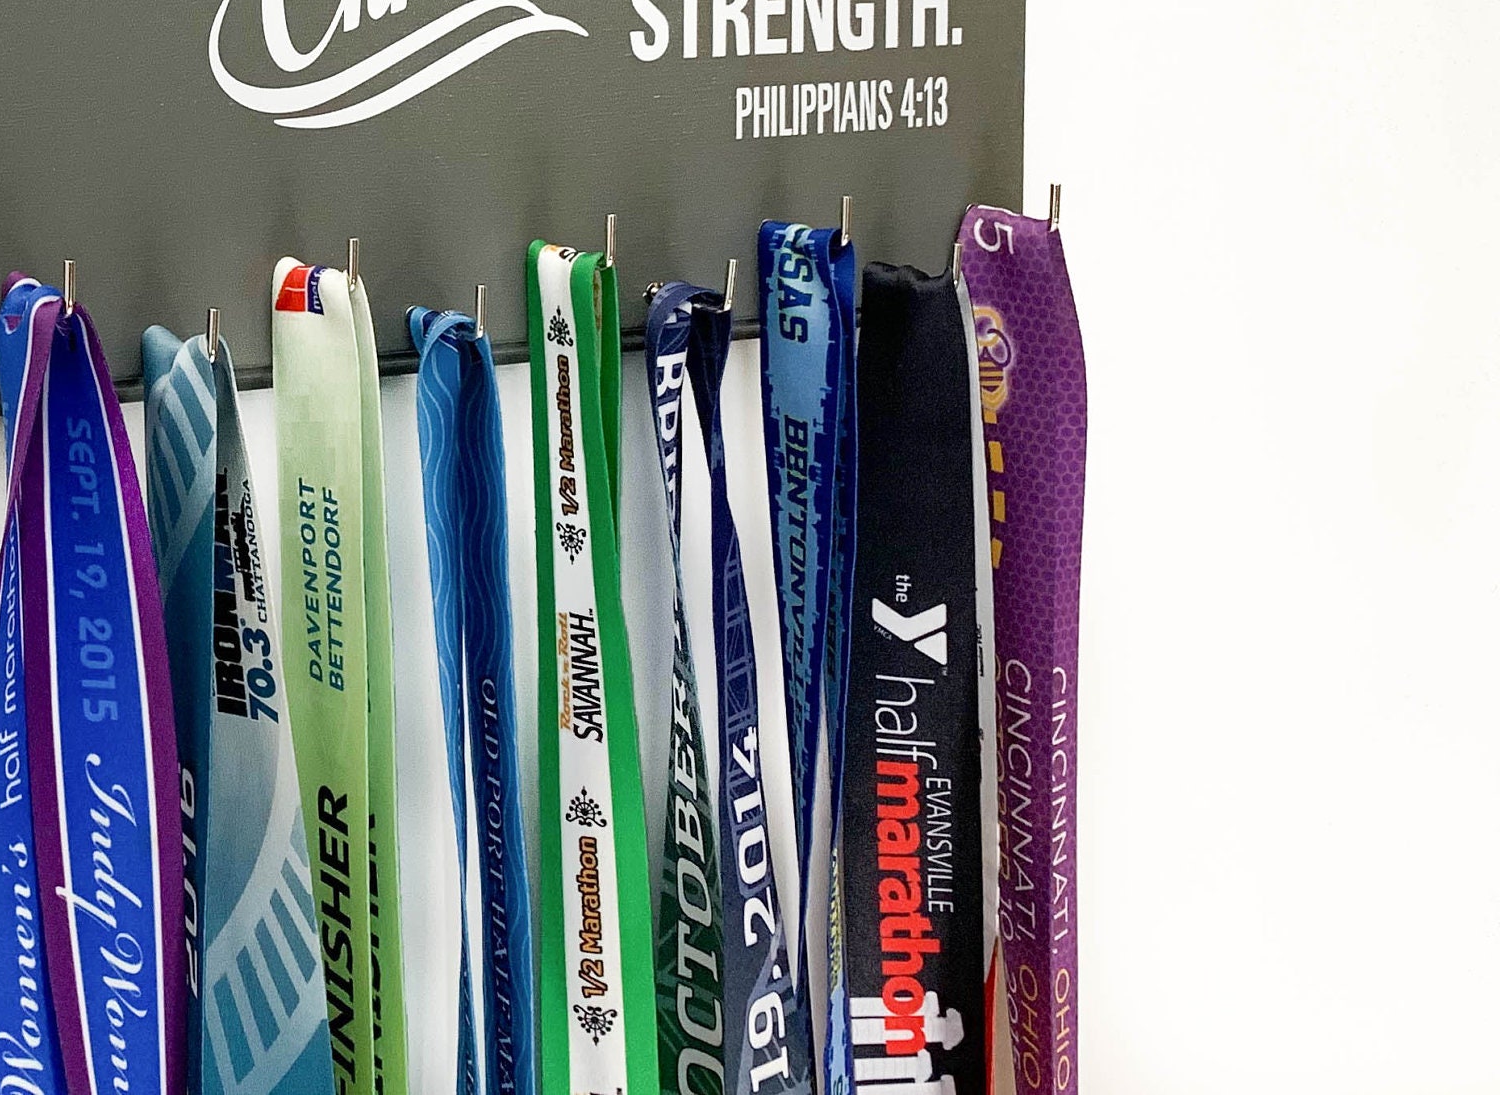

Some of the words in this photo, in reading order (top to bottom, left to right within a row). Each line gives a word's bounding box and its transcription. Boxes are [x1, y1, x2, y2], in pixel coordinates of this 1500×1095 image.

[734, 78, 894, 141] PHILIPPIANS
[900, 75, 949, 130] 4:13
[973, 216, 1016, 255] 5
[66, 416, 100, 521] SEPT.
[559, 354, 576, 473] Marathon
[243, 479, 269, 624] CHATTANOOGA
[560, 476, 580, 517] 1/2
[68, 542, 108, 600] 19,
[298, 477, 324, 683] DAVENPORT
[322, 486, 345, 692] BETTENDORF
[895, 574, 912, 603] the
[78, 616, 119, 723] 2015
[242, 626, 279, 725] 70.3
[558, 611, 569, 657] Roll
[873, 624, 893, 641] YMCA
[481, 677, 500, 761] OLD
[560, 676, 571, 730] Rock
[0, 729, 23, 809] half
[1004, 658, 1037, 941] CINCINNATI,
[55, 753, 143, 931] Indy
[485, 772, 506, 889] PORT
[673, 673, 726, 1095] OCTOBER
[732, 726, 777, 948] 2014
[925, 776, 954, 914] EVANSVILLE
[576, 836, 603, 954] Marathon
[490, 900, 512, 1020] HALF
[577, 959, 606, 999] 1/2
[1019, 963, 1043, 1090] OHIO
[1053, 966, 1071, 1091] OHIO
